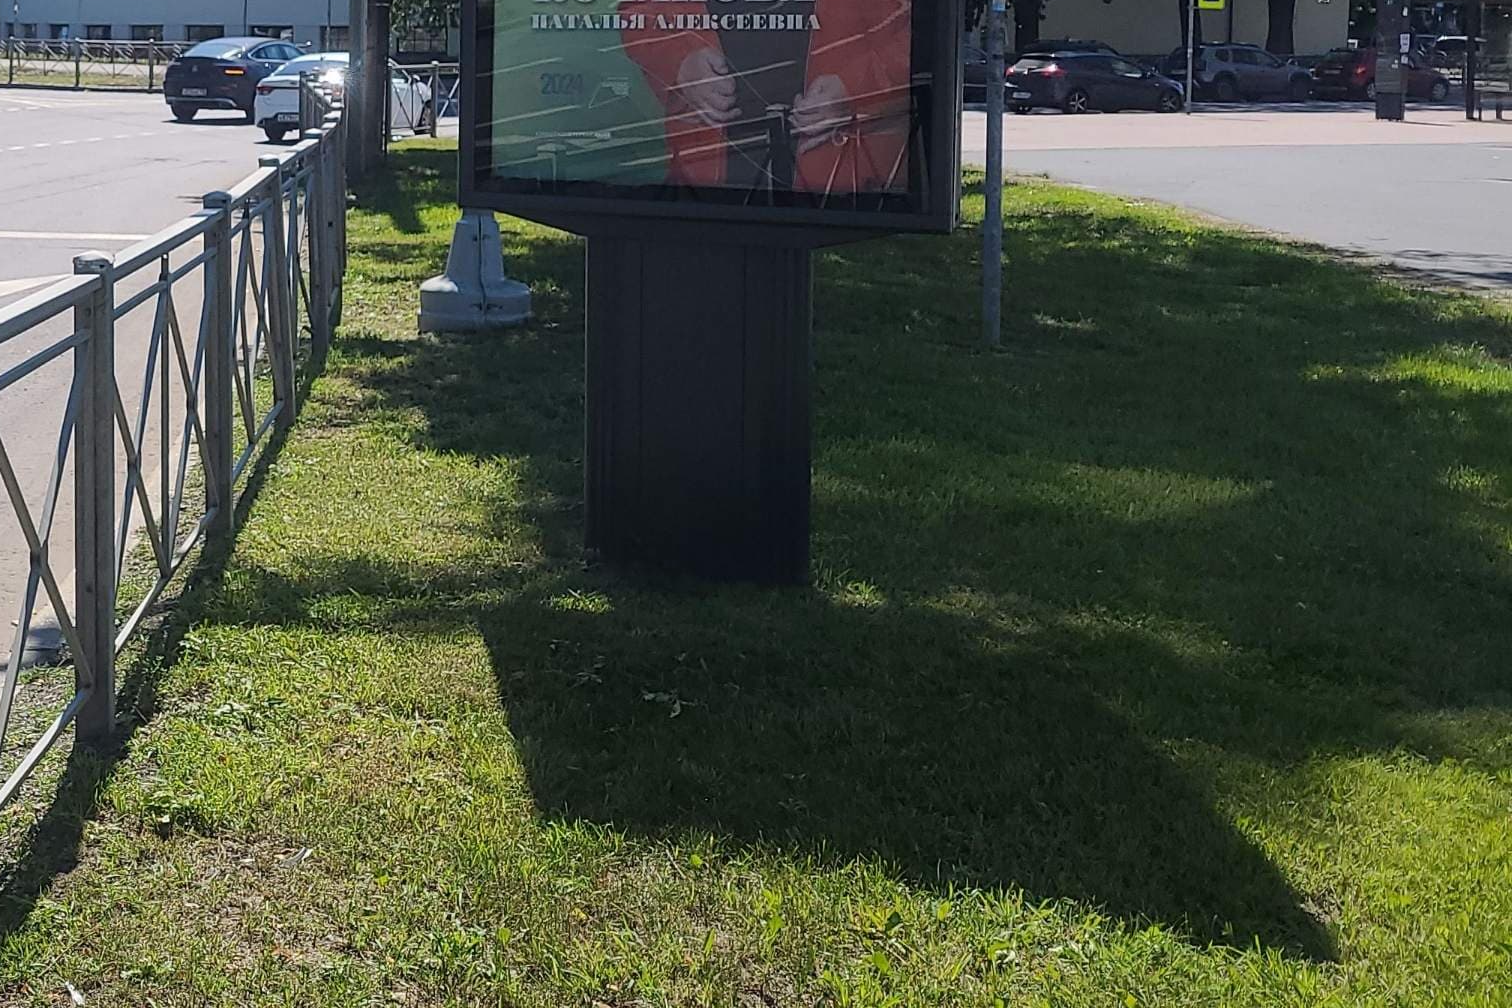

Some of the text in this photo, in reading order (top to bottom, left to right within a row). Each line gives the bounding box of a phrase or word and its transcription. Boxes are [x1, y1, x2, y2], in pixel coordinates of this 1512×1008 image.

[530, 12, 822, 31] НАТАЛЬЯ АЛЕКСЕЕВНА
[539, 72, 584, 95] 2024
